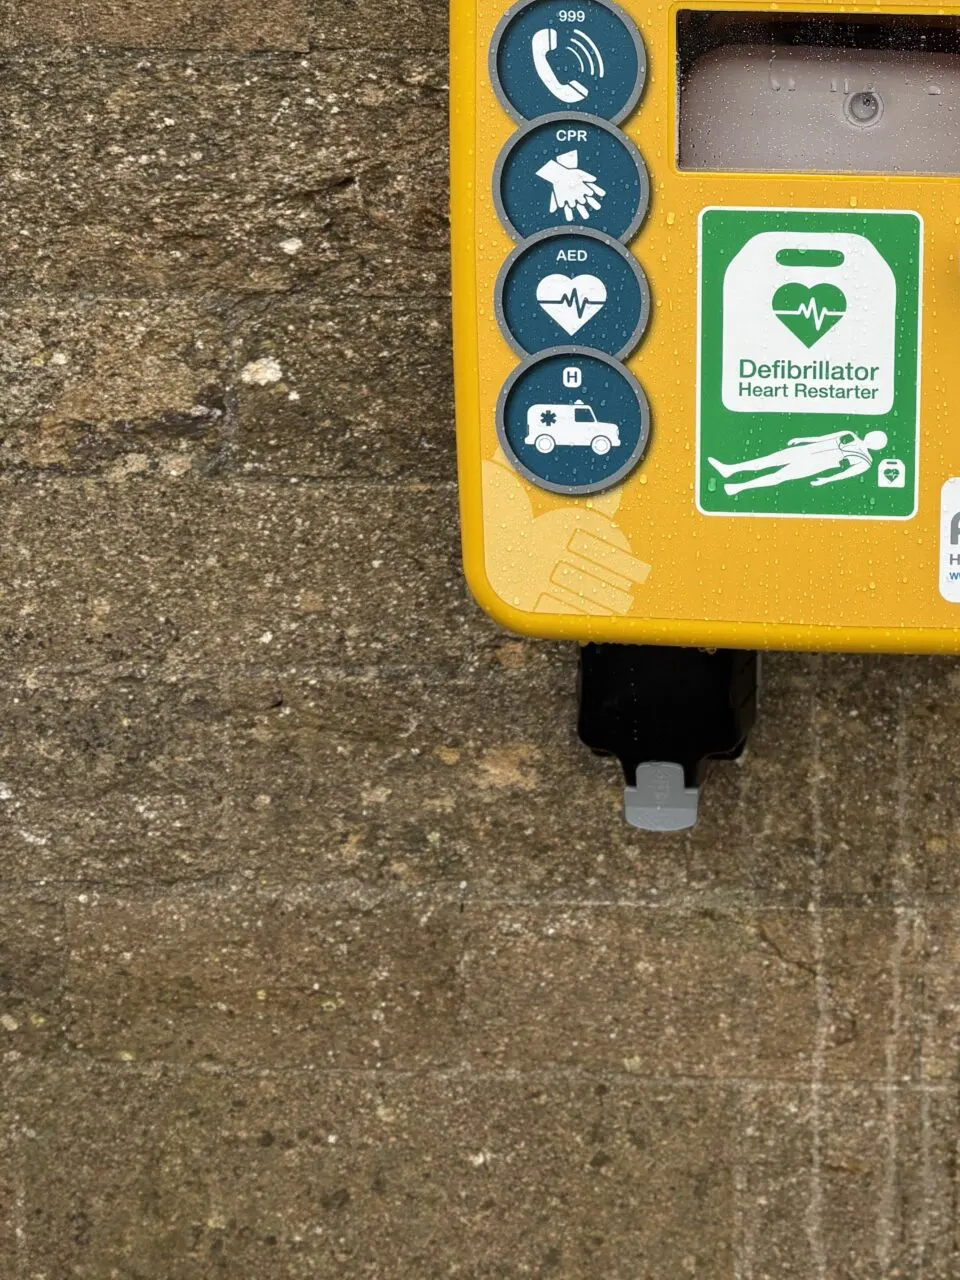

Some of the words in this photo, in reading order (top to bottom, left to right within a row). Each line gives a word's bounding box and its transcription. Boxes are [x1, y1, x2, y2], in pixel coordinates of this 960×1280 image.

[558, 10, 586, 23] 999
[555, 129, 588, 142] CPR
[556, 249, 588, 262] AED
[739, 359, 879, 381] Defibrillator
[566, 371, 579, 384] H
[738, 383, 789, 398] Heart
[794, 383, 879, 399] Restarter
